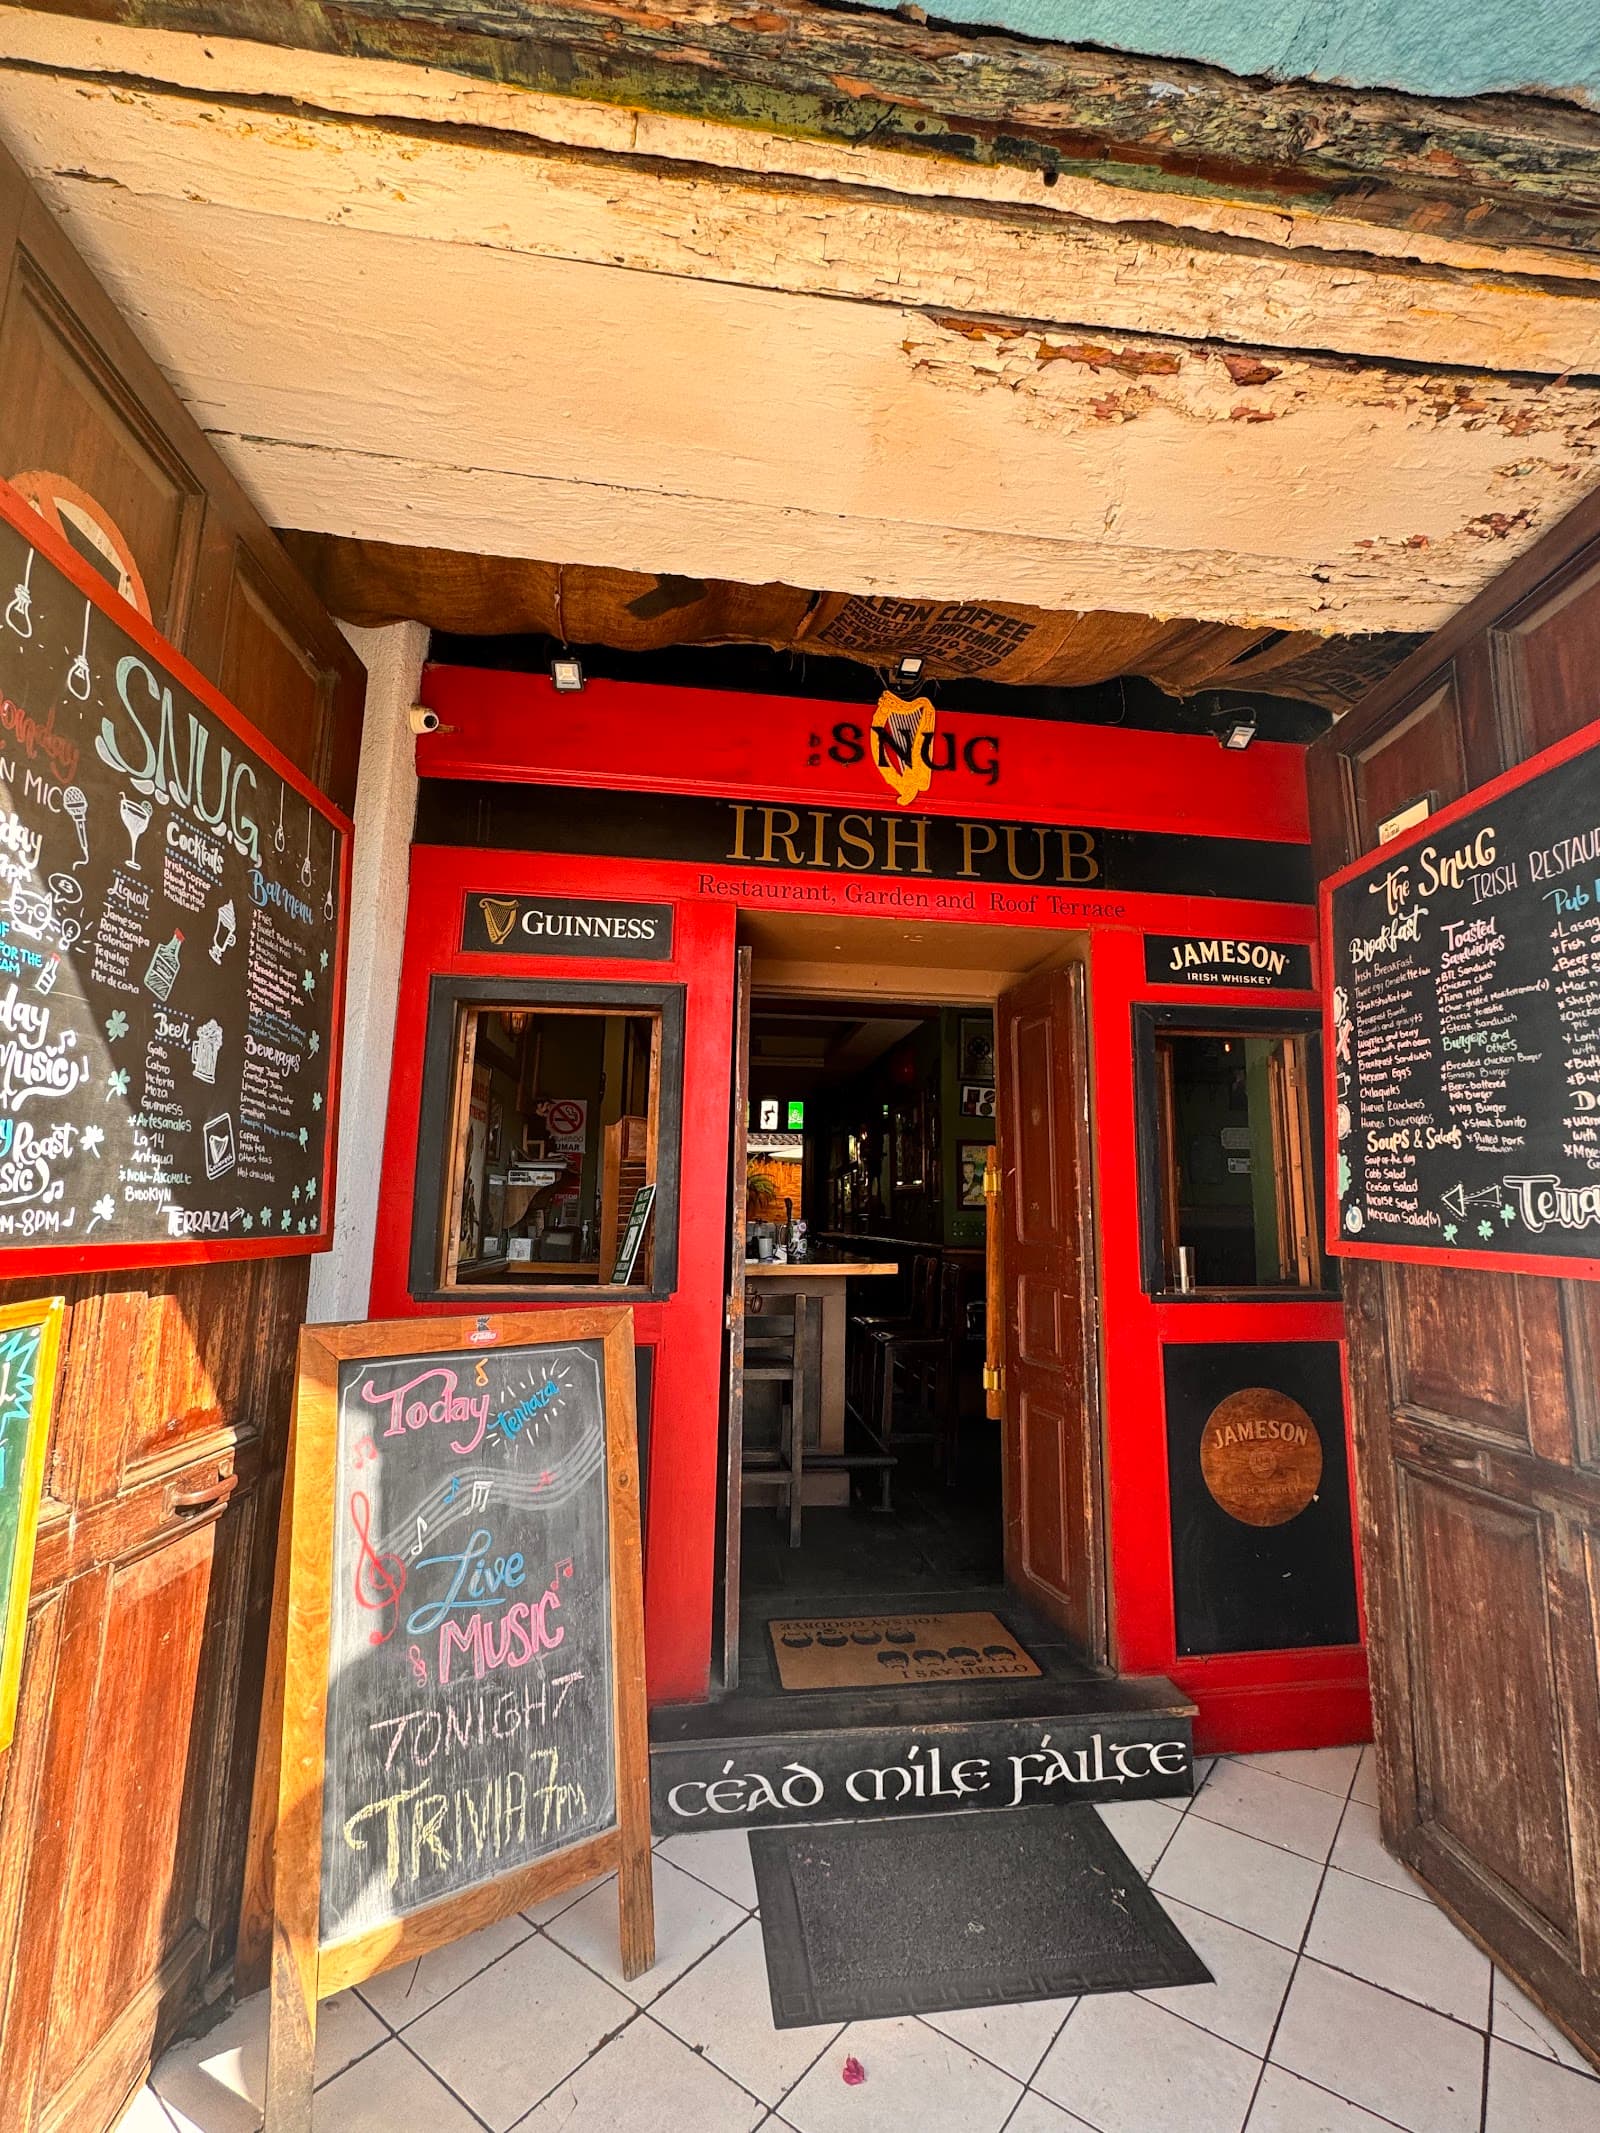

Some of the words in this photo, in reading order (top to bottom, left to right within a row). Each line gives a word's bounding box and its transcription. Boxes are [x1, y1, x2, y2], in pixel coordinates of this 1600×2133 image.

[937, 606, 1037, 642] COFFEE
[828, 721, 999, 785] SNUG
[24, 769, 63, 813] MIC
[166, 821, 225, 875] Cocktails
[726, 804, 932, 873] IRISH
[956, 821, 1102, 883] PUB
[164, 855, 186, 877] Irish
[247, 869, 282, 908] Bar
[1467, 862, 1519, 905] IRISH
[698, 874, 836, 904] Restaurant,
[845, 883, 928, 907] Garden
[936, 891, 975, 910] and
[989, 891, 1038, 914] Roof
[1047, 895, 1126, 919] Terrace
[1542, 884, 1590, 915] Pub
[100, 917, 118, 935] Ron
[102, 902, 142, 932] Jameson
[521, 910, 658, 940] GUINNESS
[97, 930, 133, 953] Colonial
[1350, 904, 1429, 964] Breakfast
[1440, 916, 1497, 951] Toasted
[1560, 938, 1586, 954] Fish
[20, 949, 43, 968] THE
[94, 942, 130, 967] Tequilas
[1169, 940, 1287, 976] JAMESON
[1558, 953, 1589, 970] Beef
[1187, 972, 1218, 982] IRISH
[1221, 974, 1273, 985] WHISKEY
[1354, 967, 1372, 985] Irish
[1457, 959, 1497, 977] Sandwich
[1443, 992, 1463, 1002] Tuna
[1562, 981, 1588, 994] Mac
[153, 1013, 190, 1045] Beer
[1442, 1030, 1488, 1054] Burgers
[1490, 1028, 1511, 1042] and
[147, 1041, 168, 1060] Gallo
[243, 1034, 300, 1077] Beverages
[145, 1056, 171, 1075] Cabro
[1391, 1066, 1412, 1082] Eggs
[144, 1082, 169, 1099] Moza
[145, 1070, 175, 1090] Victoria
[140, 1095, 184, 1117] Guinness
[1455, 1103, 1473, 1115] Veg
[136, 1111, 192, 1132] Artesanales
[13, 1122, 79, 1165] Roast
[133, 1129, 148, 1148] La
[149, 1132, 165, 1150] 14
[1367, 1129, 1410, 1153] Soups
[1413, 1128, 1423, 1149] &
[1426, 1124, 1462, 1150] Salads
[1473, 1132, 1499, 1144] Pulled
[130, 1147, 174, 1172] Antigua
[1403, 1154, 1416, 1167] day
[1383, 1167, 1407, 1180] Salad
[1393, 1178, 1418, 1192] Salad
[161, 1205, 230, 1237] TERRAZA
[362, 1368, 490, 1454] Today
[1214, 1419, 1309, 1450] JAMESON
[406, 1528, 526, 1636] Live
[438, 1590, 565, 1684] MUSIC
[902, 1670, 909, 1679] I
[916, 1669, 953, 1678] SAY
[959, 1664, 1028, 1676] HELLO
[370, 1671, 586, 1772] TONIGHT
[343, 1777, 527, 1890] TRIVIA
